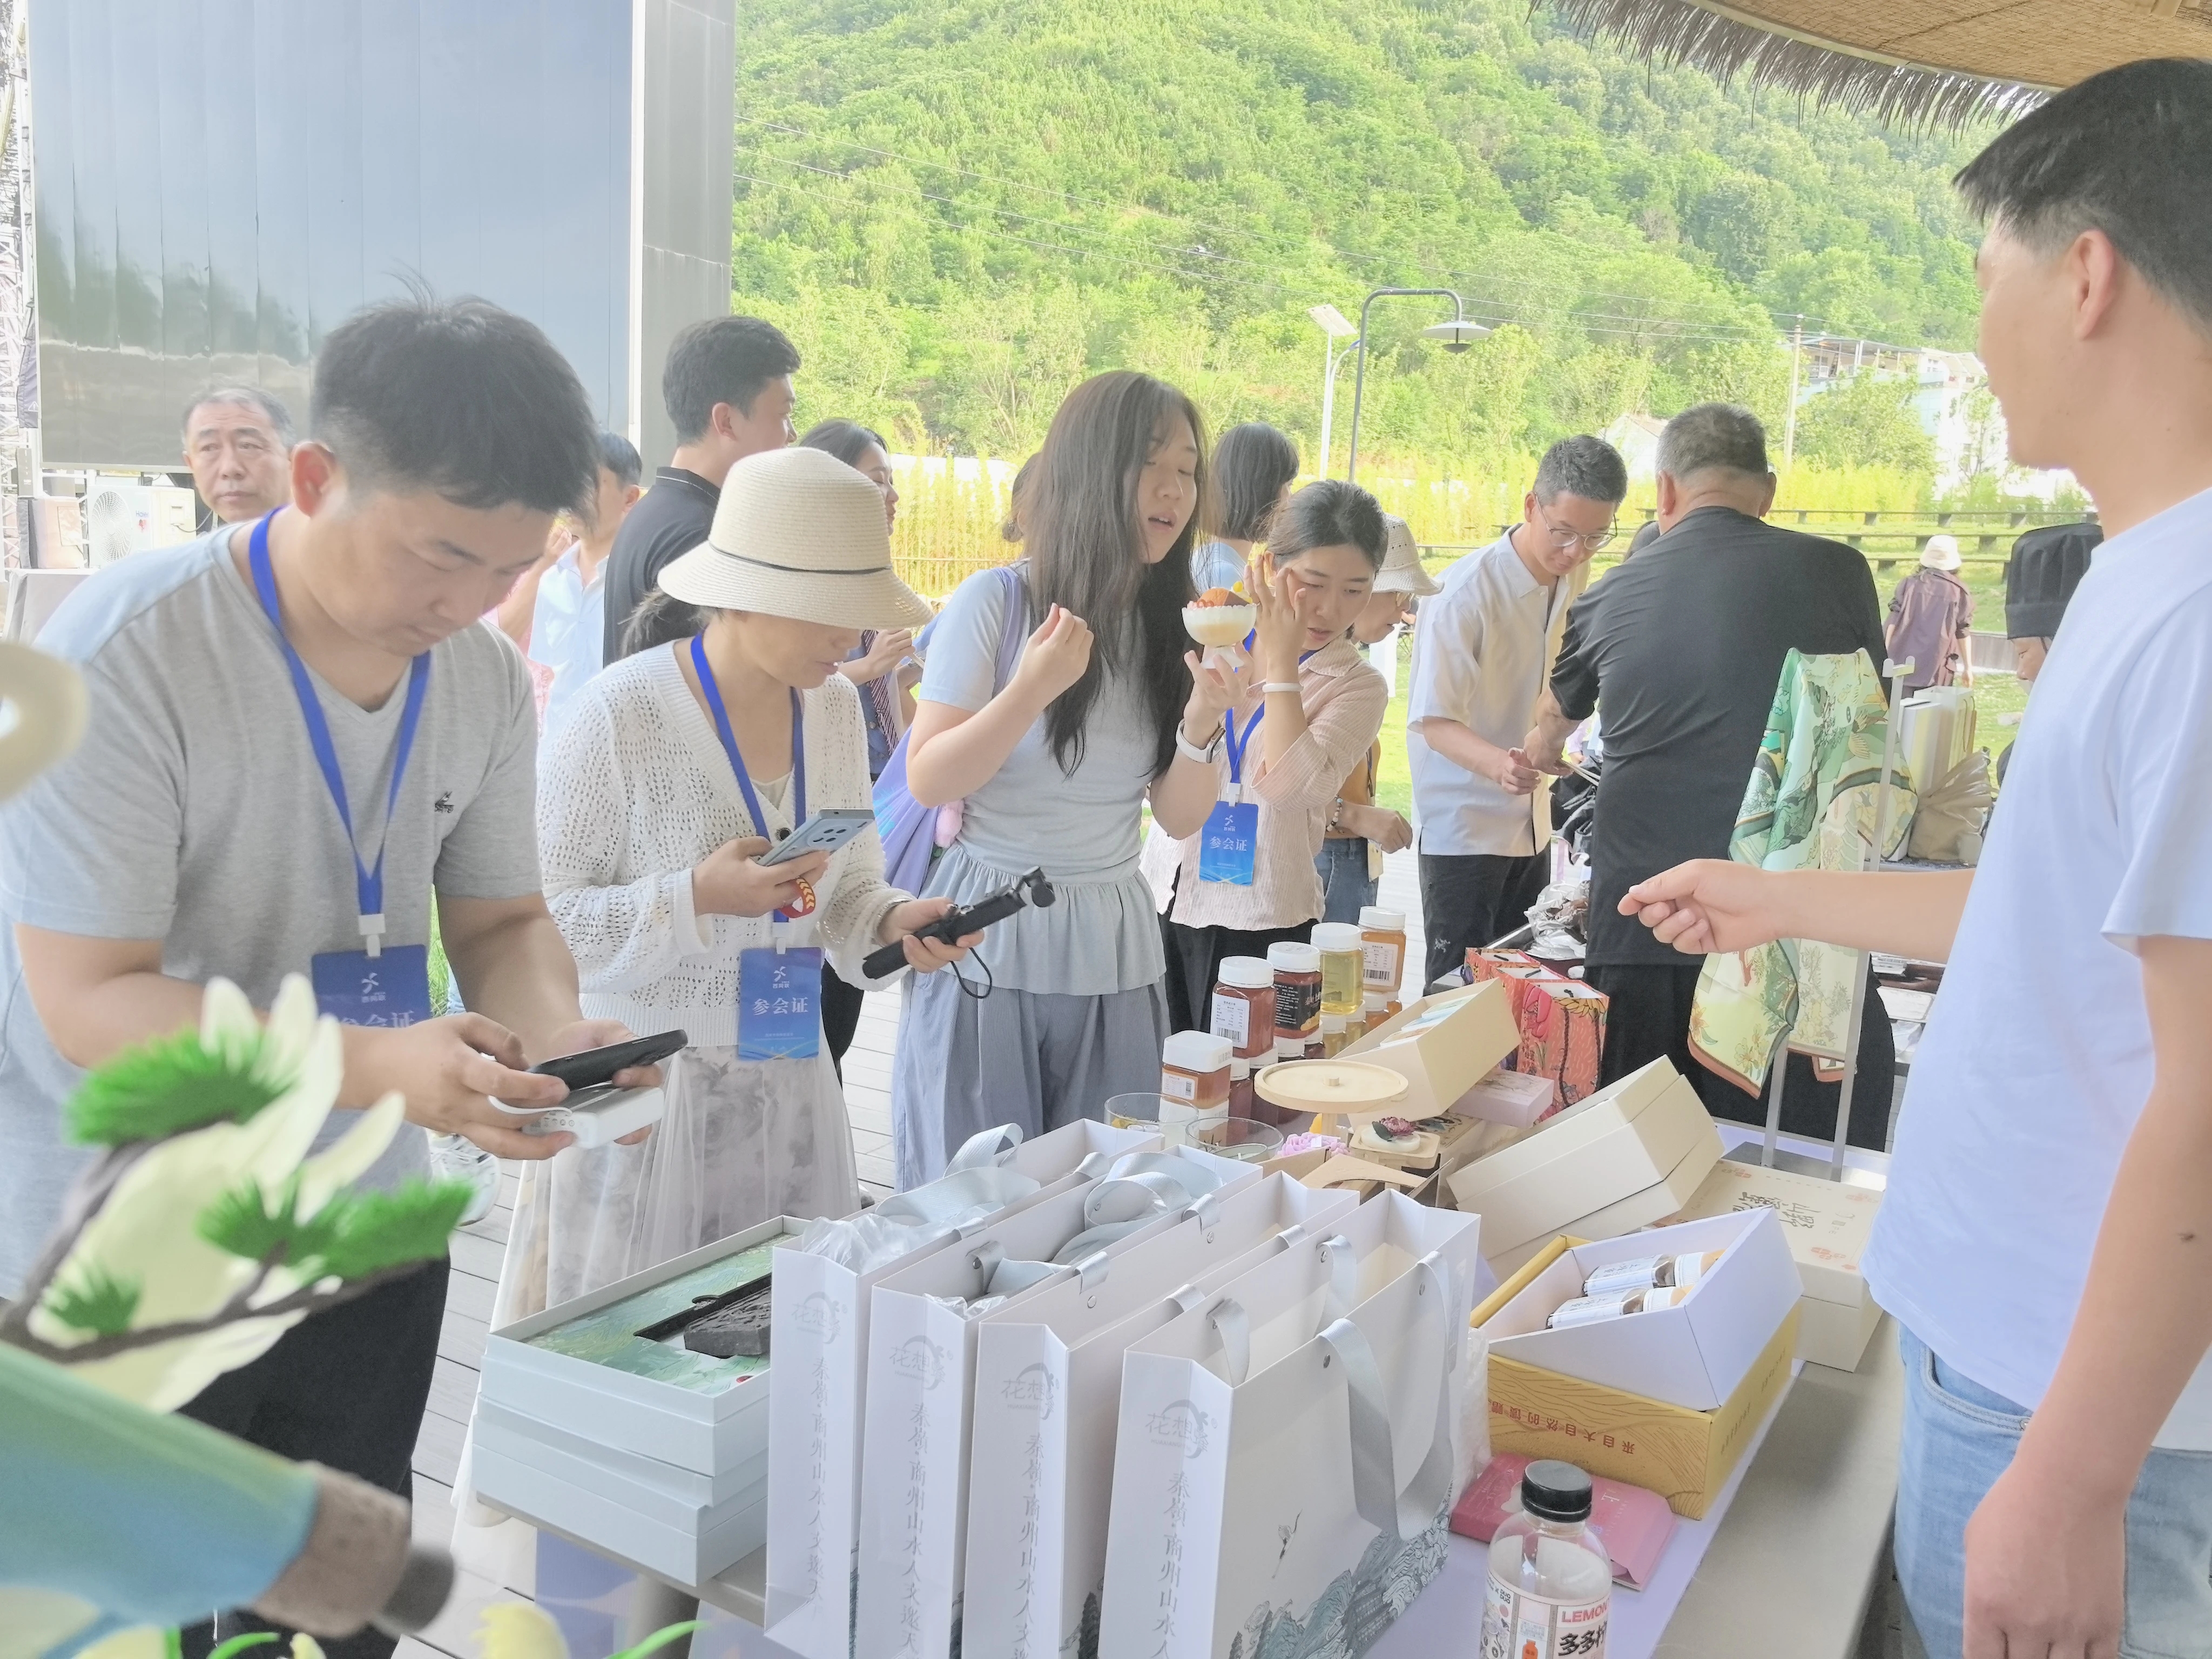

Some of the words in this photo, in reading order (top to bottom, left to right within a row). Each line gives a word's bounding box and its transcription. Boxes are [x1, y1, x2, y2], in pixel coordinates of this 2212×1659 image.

[1210, 836, 1247, 852] 参会证
[753, 996, 808, 1016] 参会证
[1491, 1401, 1635, 1455] 来自大自然的馈赠
[1500, 1588, 1511, 1599] DUO
[1500, 1594, 1510, 1604] DUO
